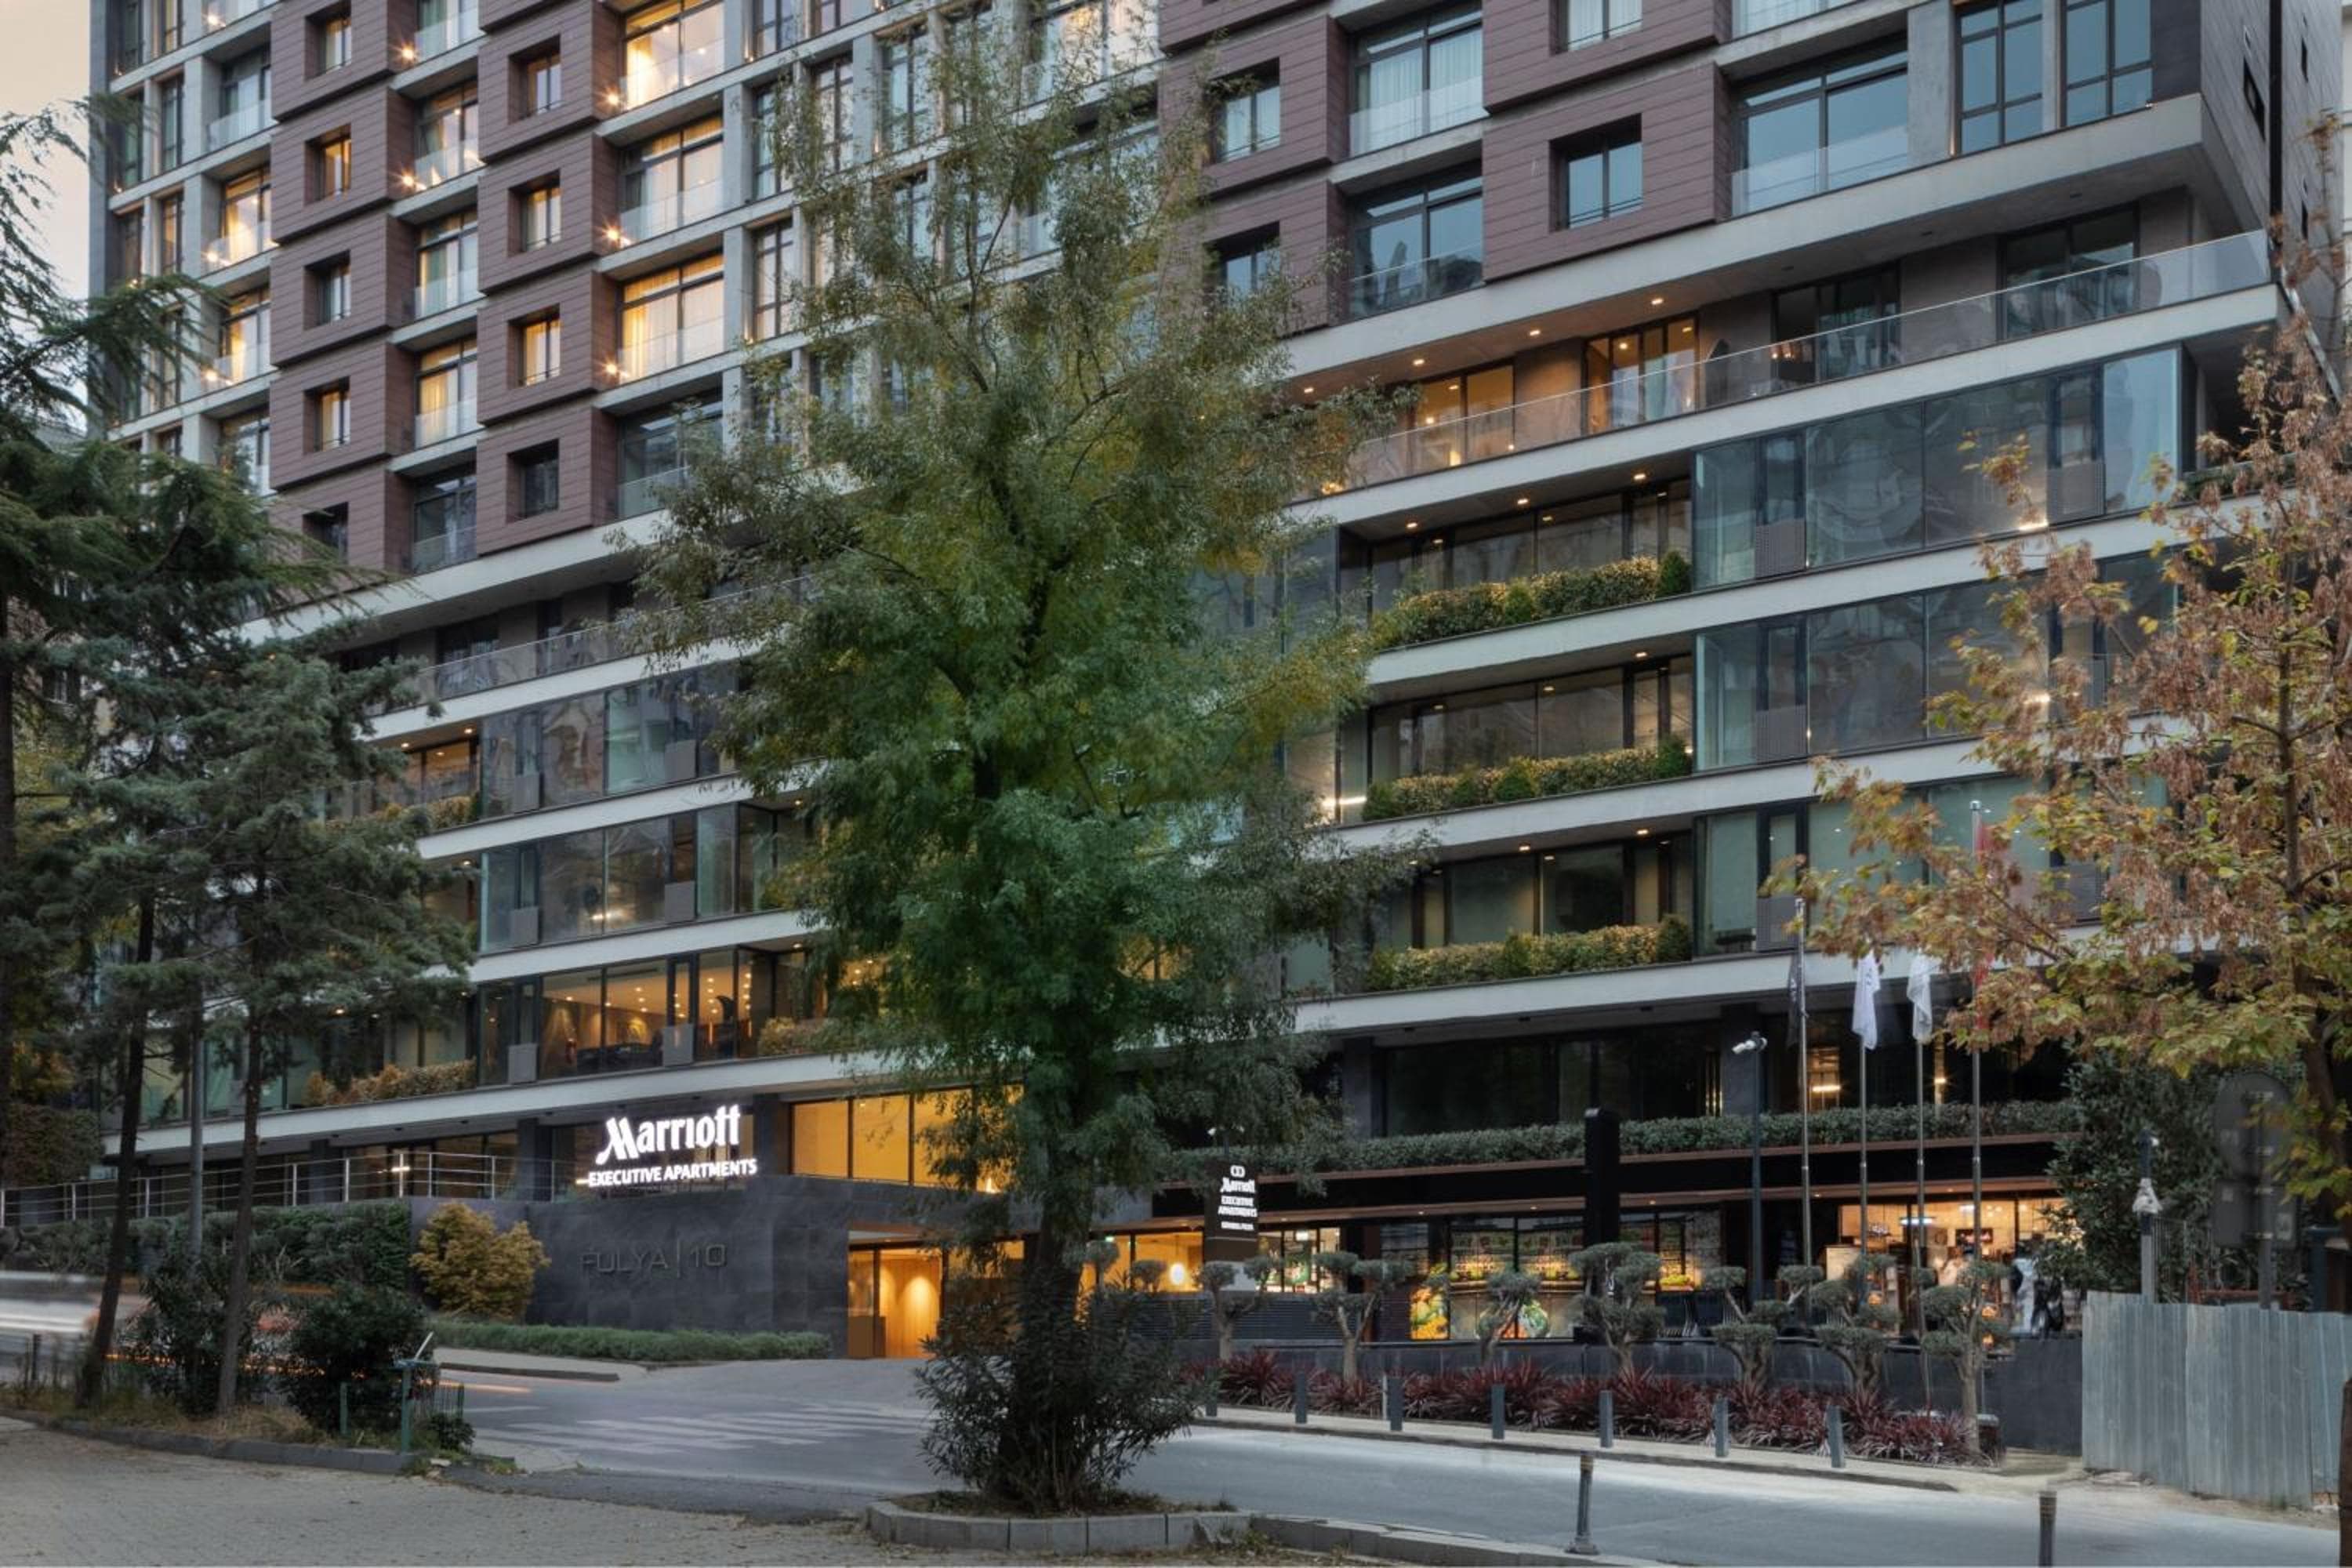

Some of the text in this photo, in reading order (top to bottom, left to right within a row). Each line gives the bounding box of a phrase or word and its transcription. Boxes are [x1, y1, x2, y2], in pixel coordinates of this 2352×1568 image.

[595, 1104, 741, 1165] Marriott
[589, 1159, 757, 1188] EXECUTIVE APARTMENTS
